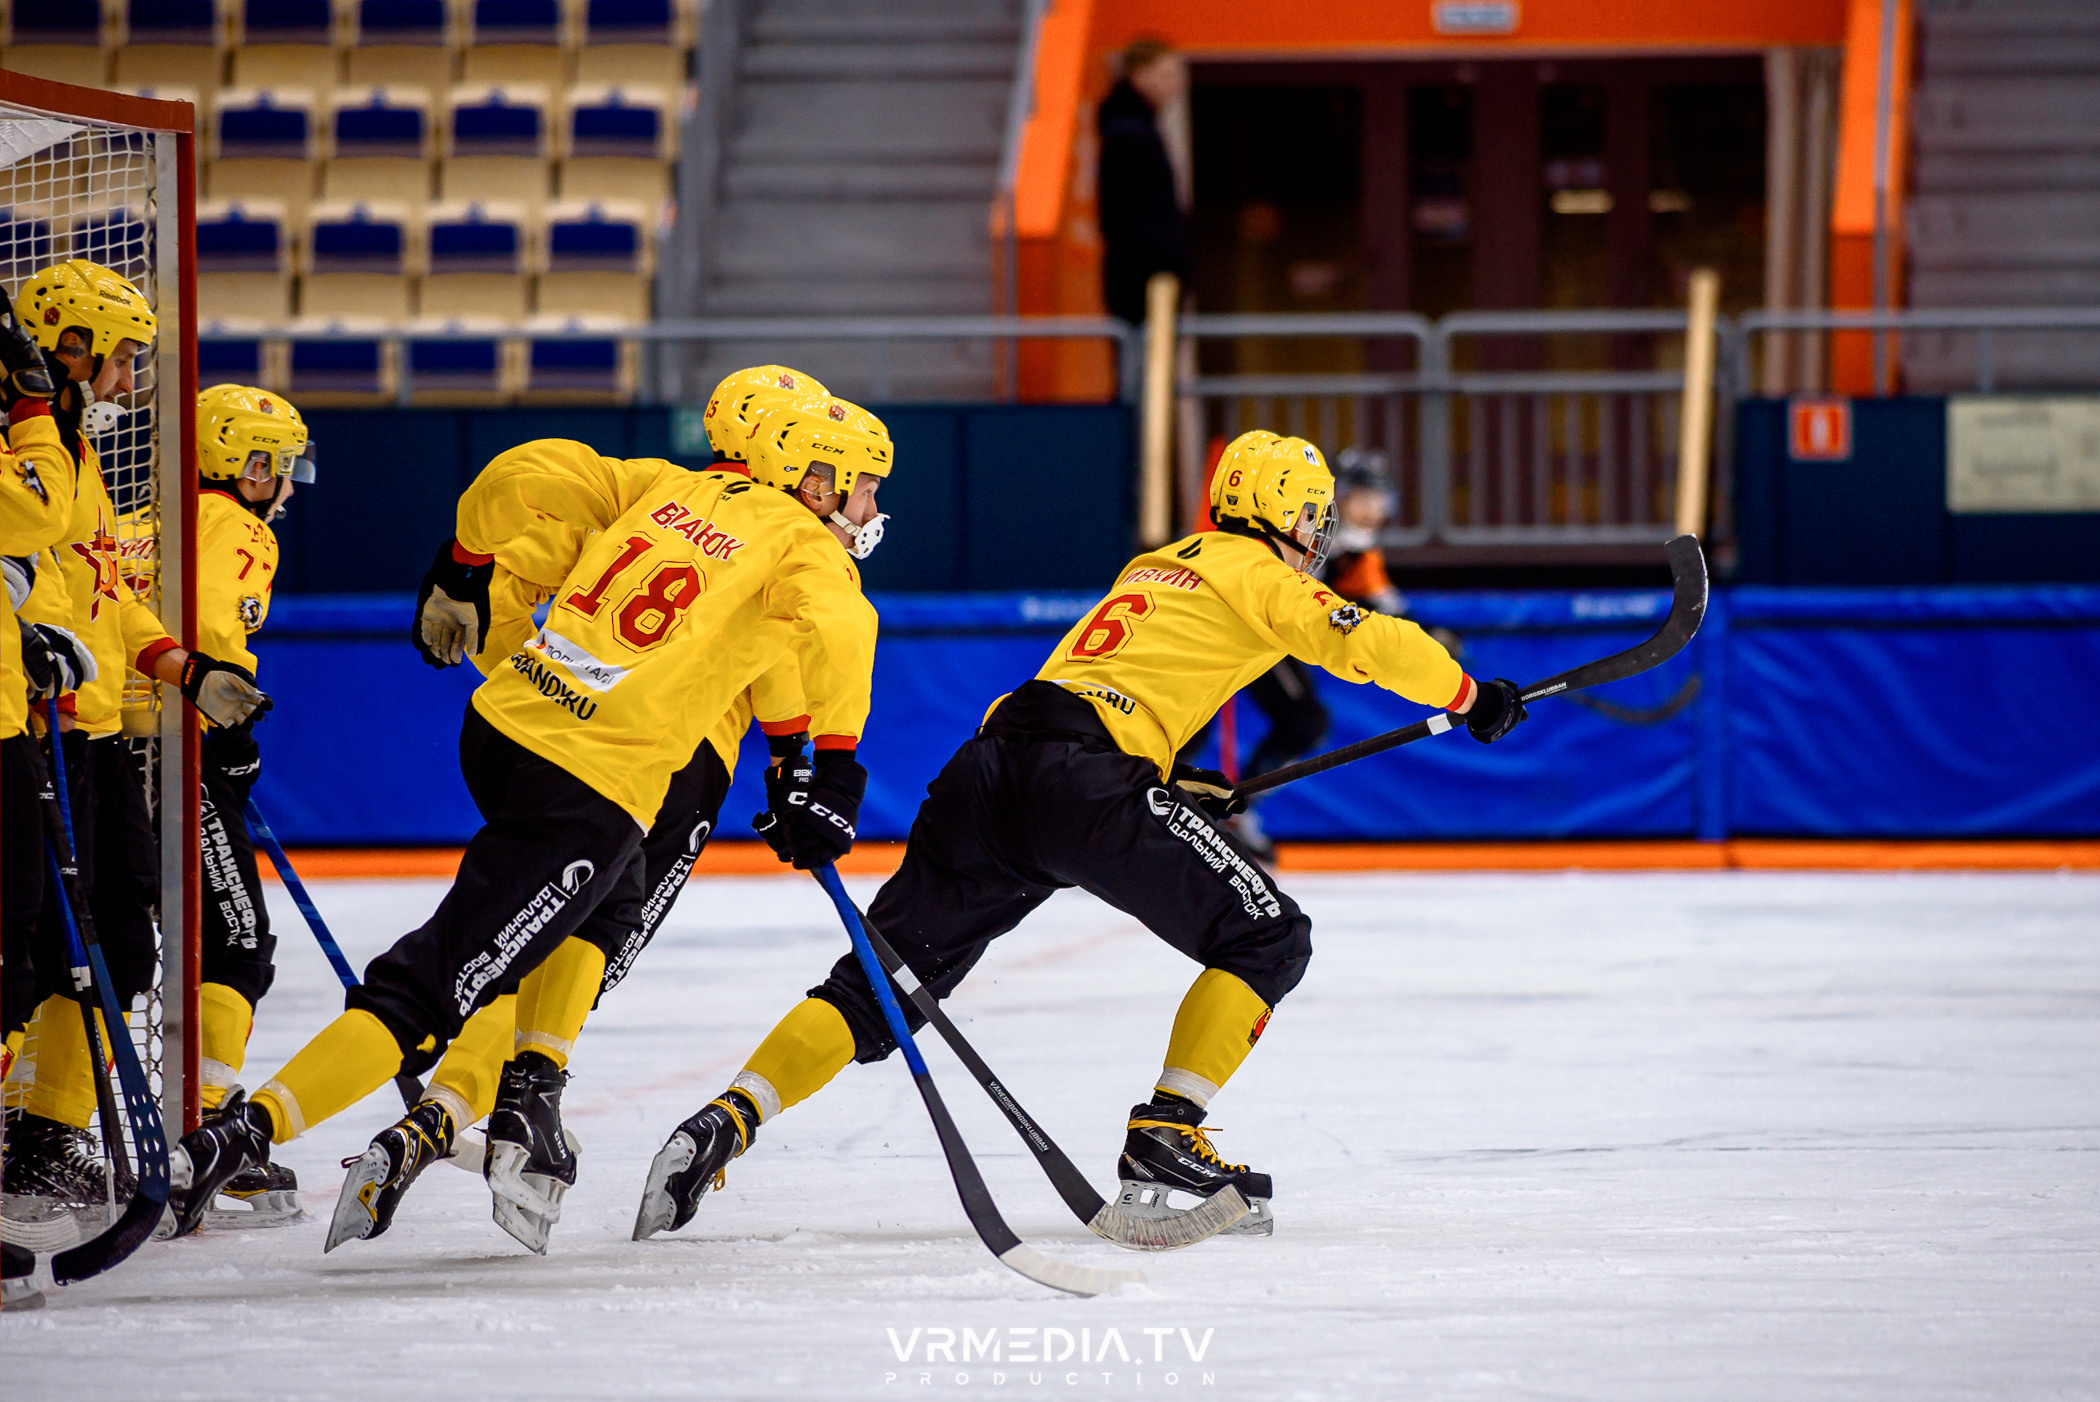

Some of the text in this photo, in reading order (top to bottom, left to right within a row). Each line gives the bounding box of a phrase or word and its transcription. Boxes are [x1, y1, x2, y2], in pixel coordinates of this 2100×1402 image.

[252, 435, 280, 445] CCM
[811, 443, 845, 455] CCM
[1304, 450, 1316, 463] M
[1228, 470, 1243, 487] 6
[558, 530, 707, 655] 18
[1065, 590, 1156, 663] 6
[221, 758, 260, 776] CM
[809, 802, 856, 839] CCM
[208, 817, 258, 949] ТРАНСНЕФТЬ
[1168, 822, 1265, 920] ДАЛЬНИЙ ВОСТОК
[1178, 806, 1282, 918] ТРАНСНЕФТЬ
[453, 885, 552, 1002] ДАЛЬНИЙ ВОСТОК
[604, 862, 693, 991] ТРАНСНЕФТЬ
[458, 896, 566, 1017] ТРАНСНЕФТЬ
[554, 1131, 567, 1159] CCM
[1178, 1156, 1218, 1178] CCM
